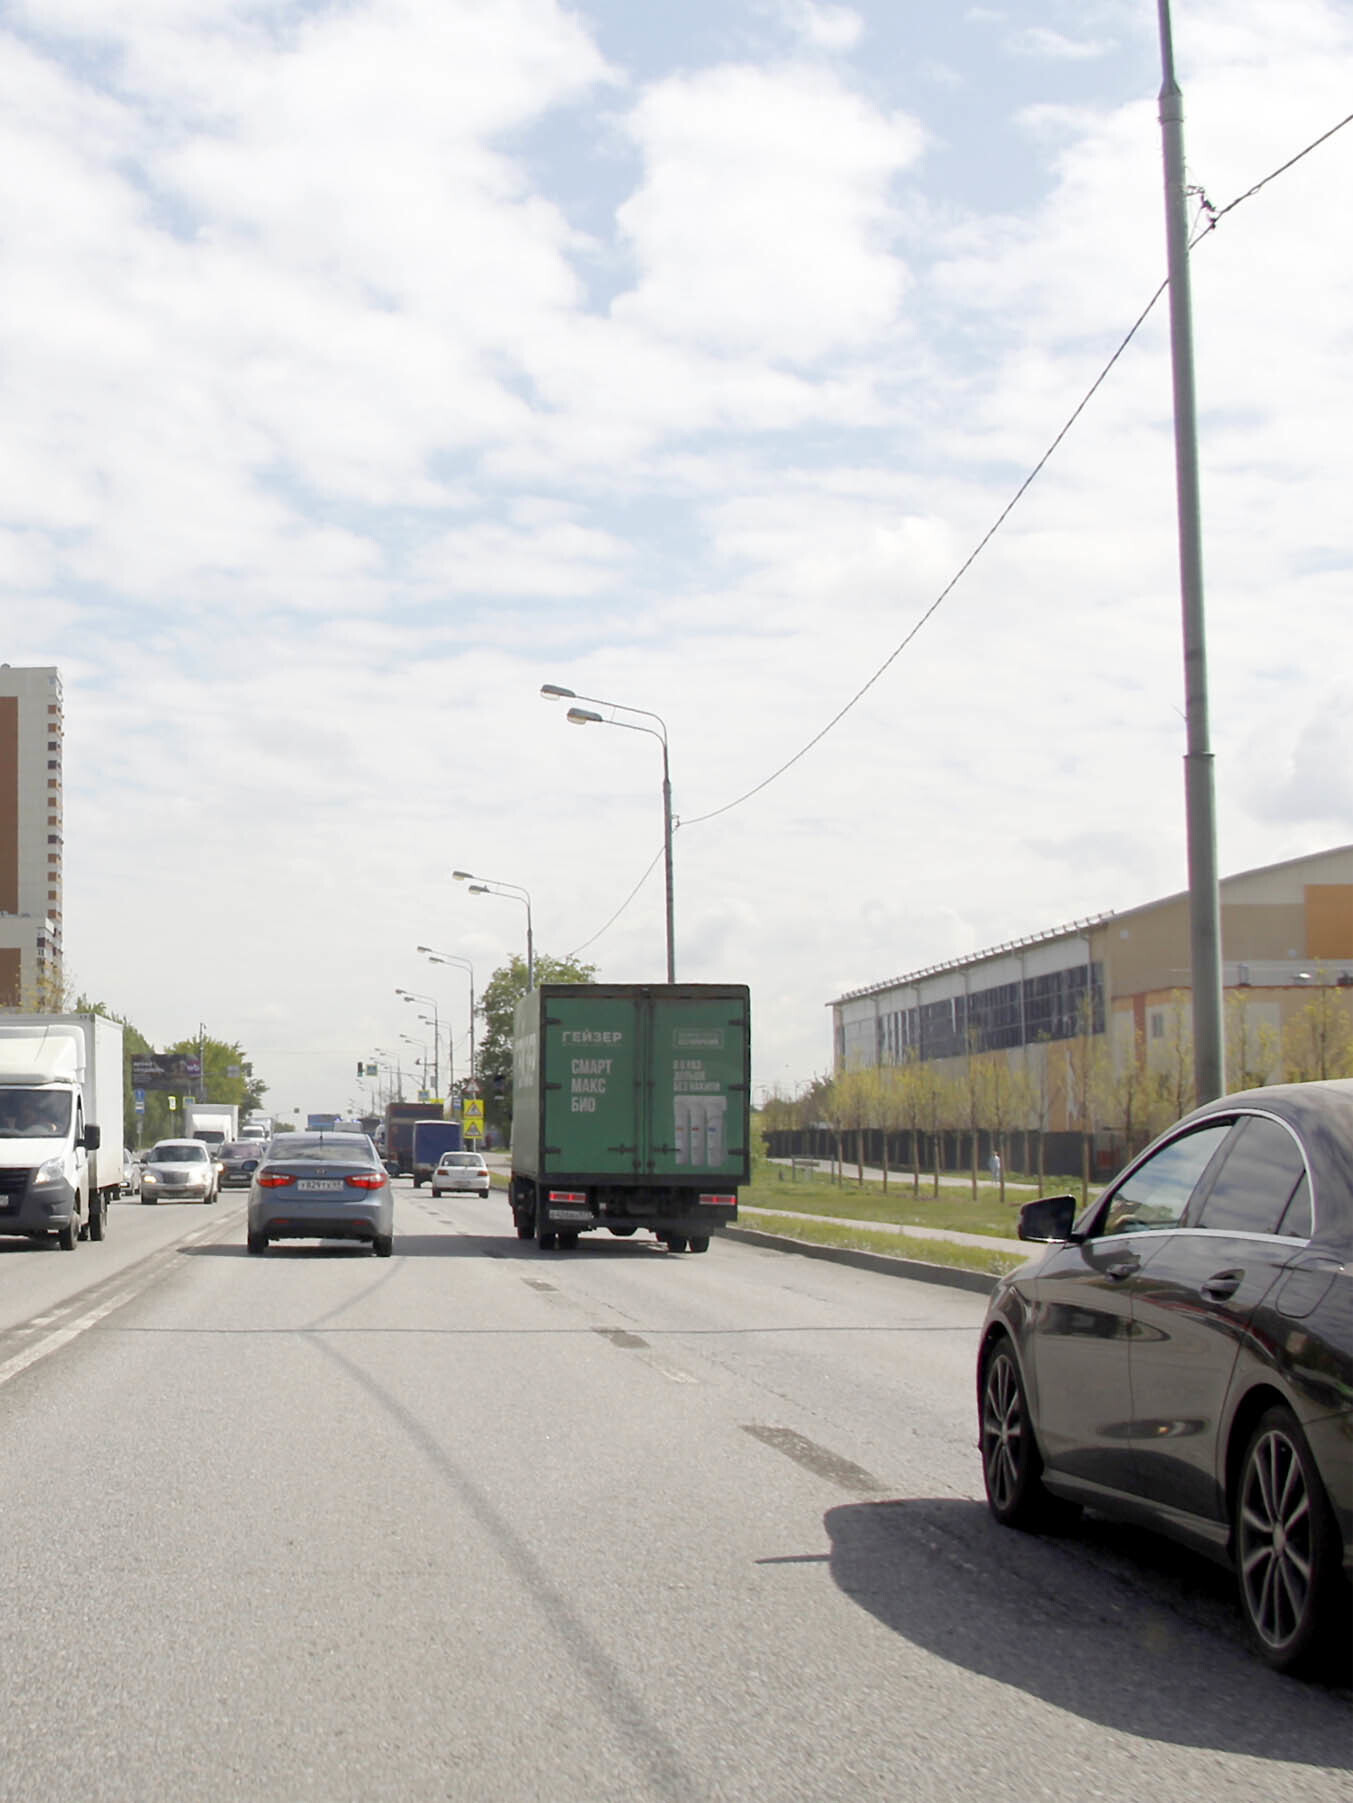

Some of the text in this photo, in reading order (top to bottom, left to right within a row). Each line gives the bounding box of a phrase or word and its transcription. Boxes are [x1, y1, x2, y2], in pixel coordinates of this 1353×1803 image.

[562, 1028, 622, 1043] ГЕЙЗЕР
[571, 1058, 613, 1075] СМАРТ
[571, 1078, 607, 1094] МАКС
[571, 1096, 597, 1112] БИО
